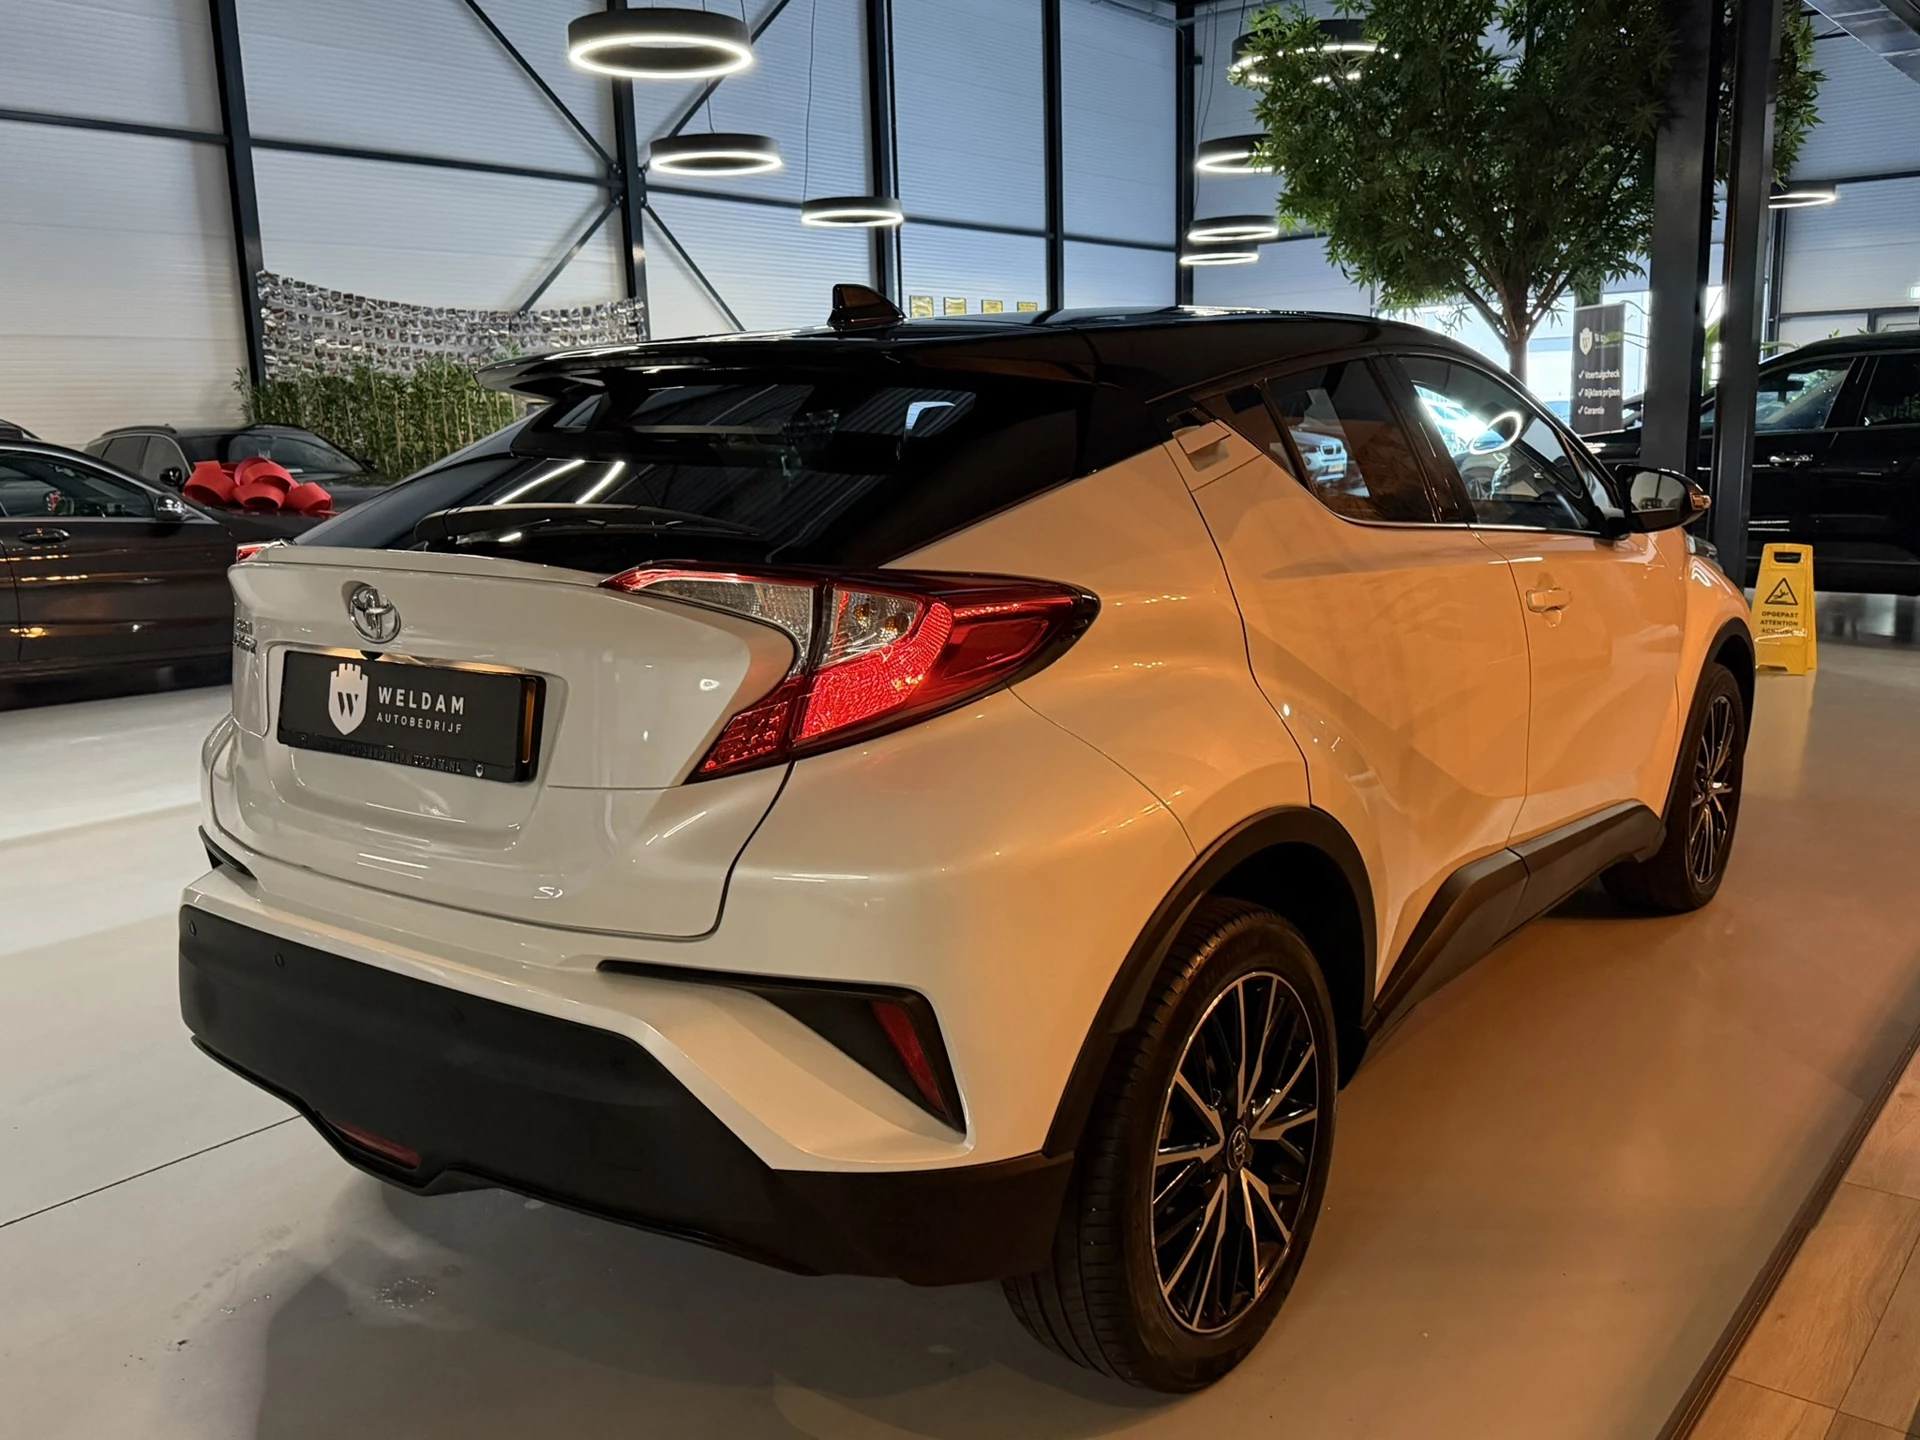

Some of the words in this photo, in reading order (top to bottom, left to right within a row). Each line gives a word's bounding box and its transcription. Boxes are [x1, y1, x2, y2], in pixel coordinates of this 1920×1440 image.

[1585, 369, 1620, 381] Voertuigcheck
[1584, 406, 1605, 415] Garantie
[337, 691, 359, 717] W
[378, 686, 465, 715] WELDAM
[376, 712, 462, 733] AUTOBEDRIJF
